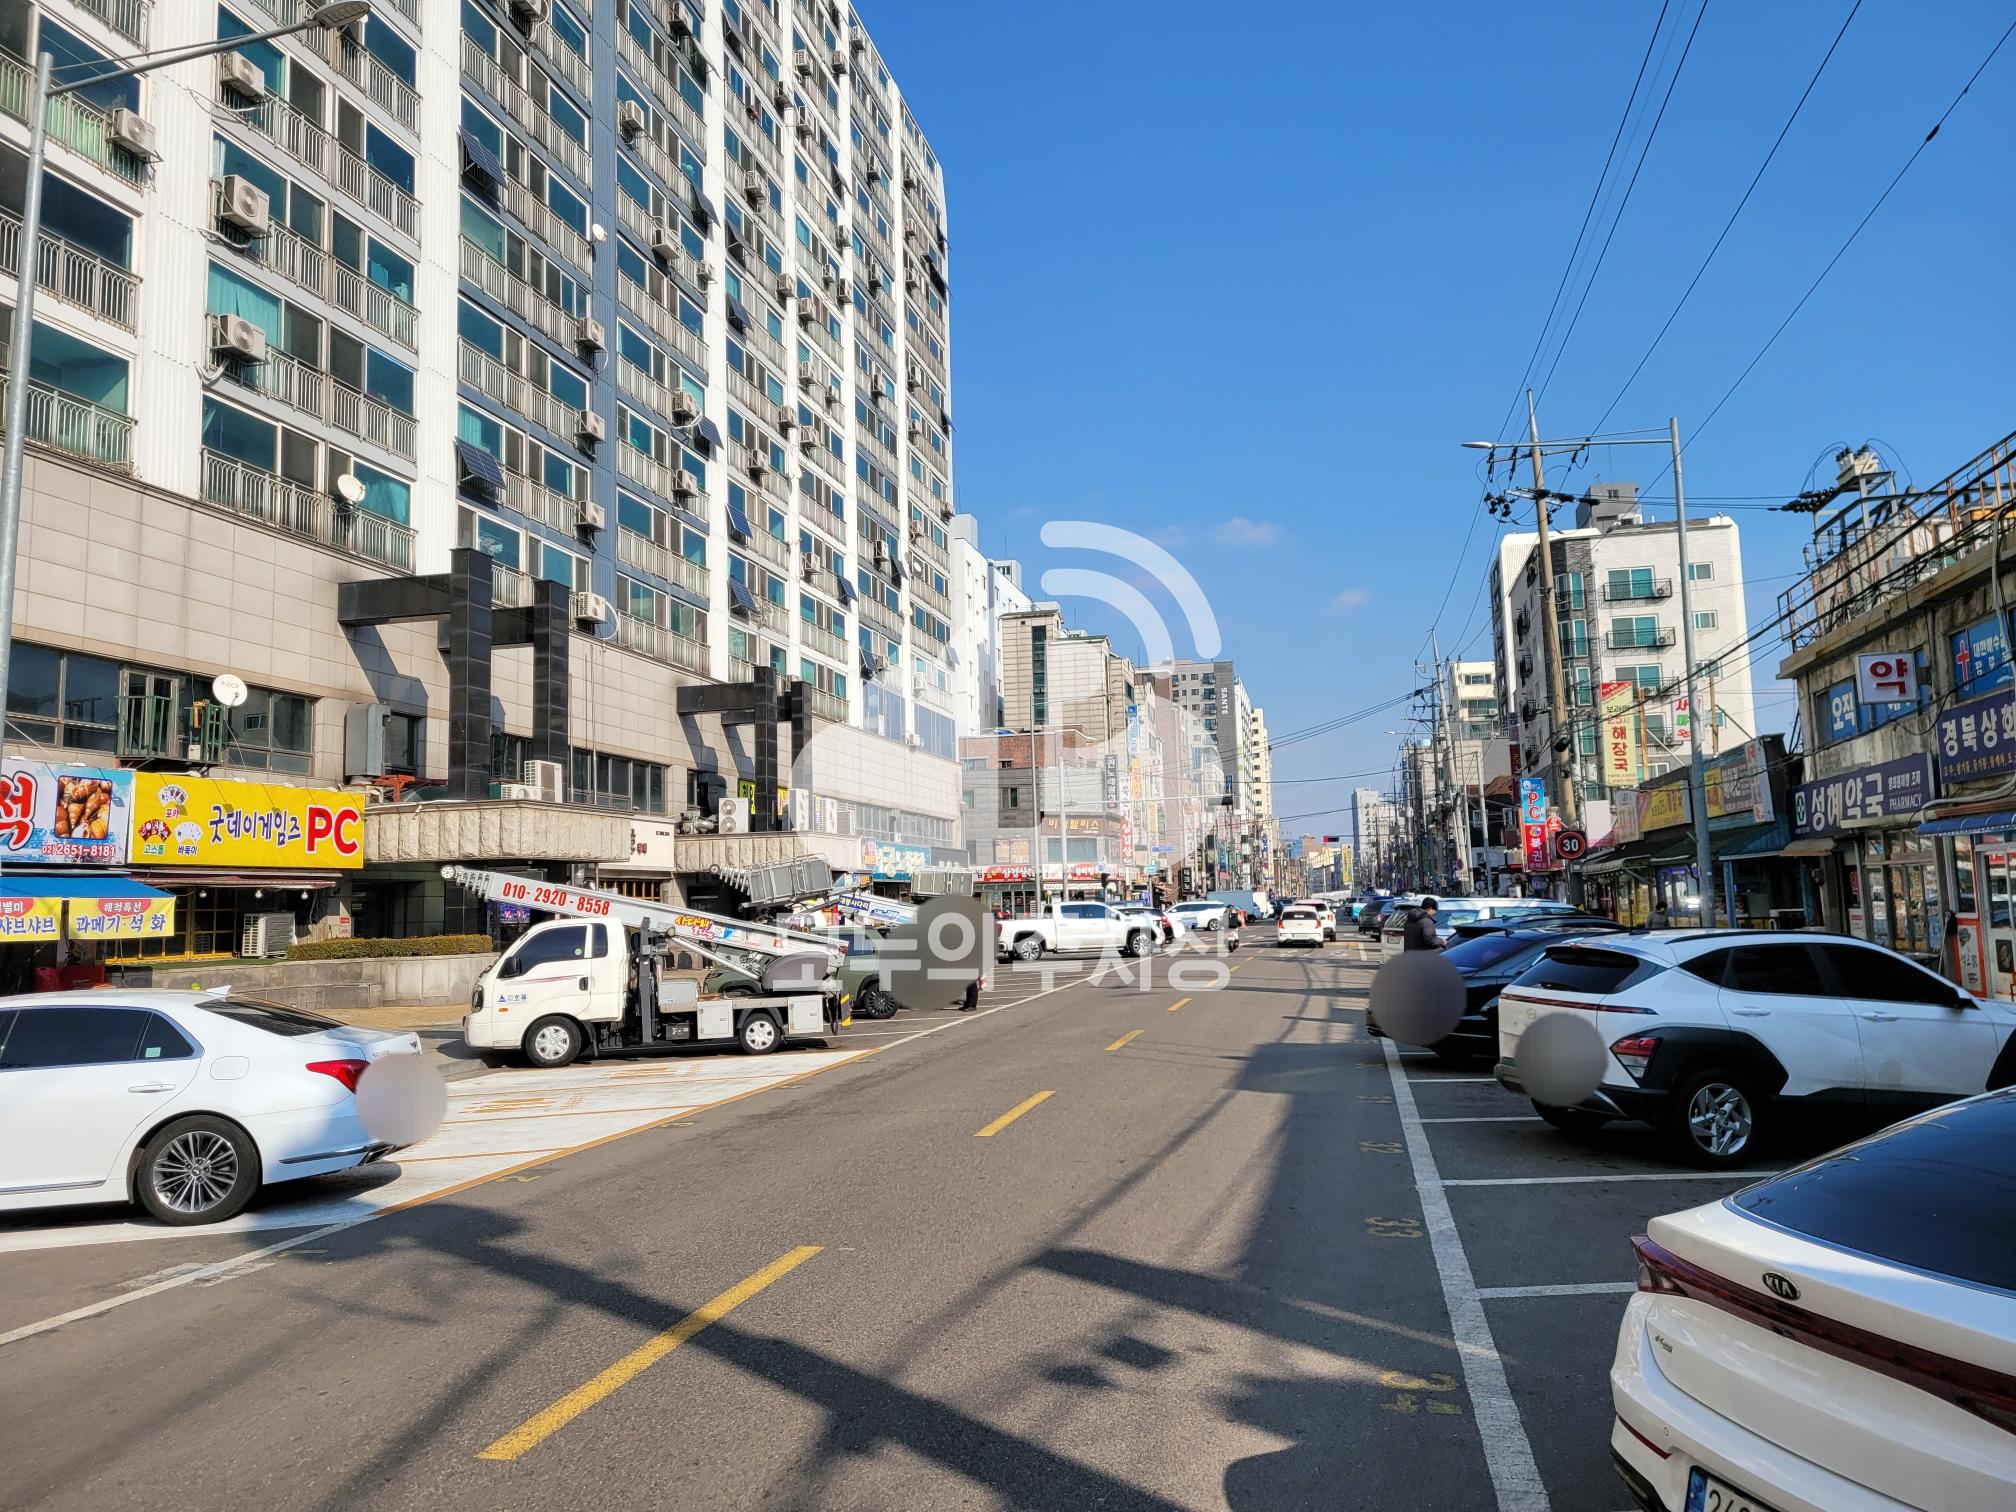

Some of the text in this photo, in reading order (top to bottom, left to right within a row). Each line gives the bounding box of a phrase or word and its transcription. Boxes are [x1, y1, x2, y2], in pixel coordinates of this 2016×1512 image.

[1869, 658, 1908, 695] 약
[1221, 687, 1229, 715] SANTE
[1832, 691, 1856, 730] 오직
[1612, 726, 1628, 772] 해장국
[1527, 792, 1541, 820] PC
[1889, 793, 1922, 811] PHARMACY
[209, 805, 359, 854] 굿데이게임즈 PC
[42, 844, 116, 857] 02)2651-8181
[177, 845, 198, 856] 바둑이
[1563, 839, 1579, 852] 30
